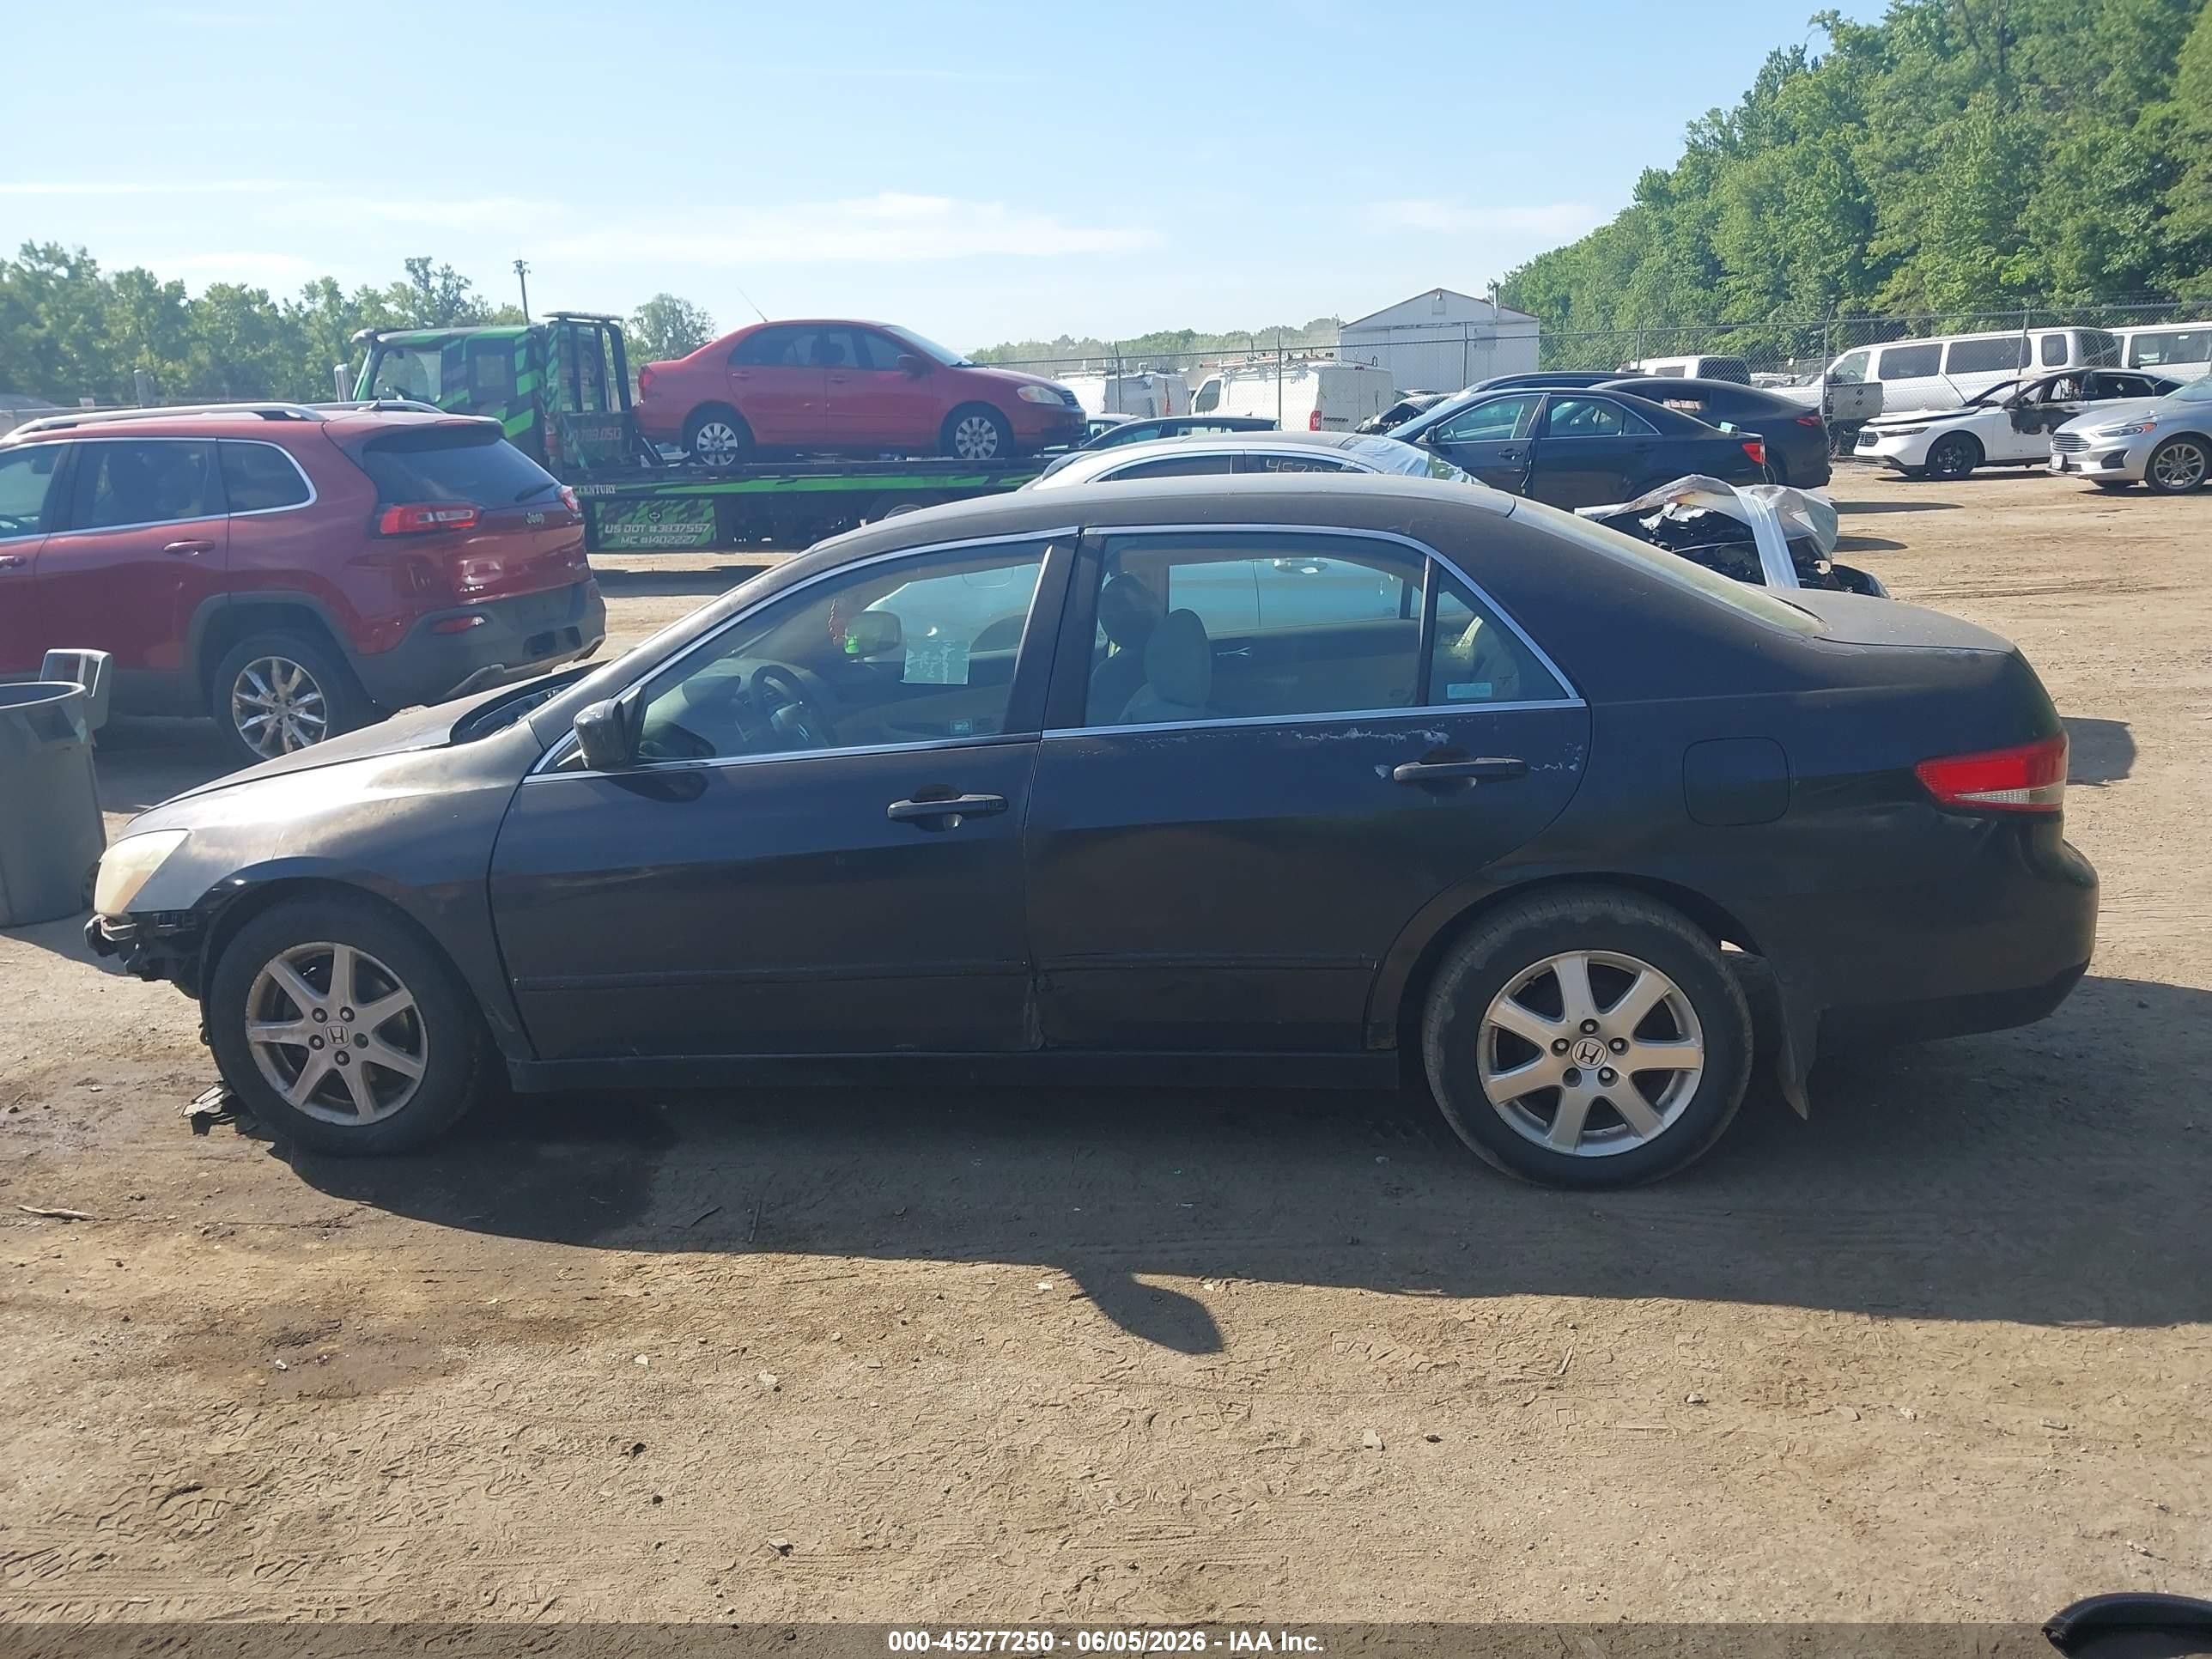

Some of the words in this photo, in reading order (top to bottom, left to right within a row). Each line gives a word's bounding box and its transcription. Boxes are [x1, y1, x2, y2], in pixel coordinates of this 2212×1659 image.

[579, 483, 617, 495] CENTURY
[605, 524, 622, 534] US
[623, 523, 647, 533] DOT
[620, 535, 640, 545] MC
